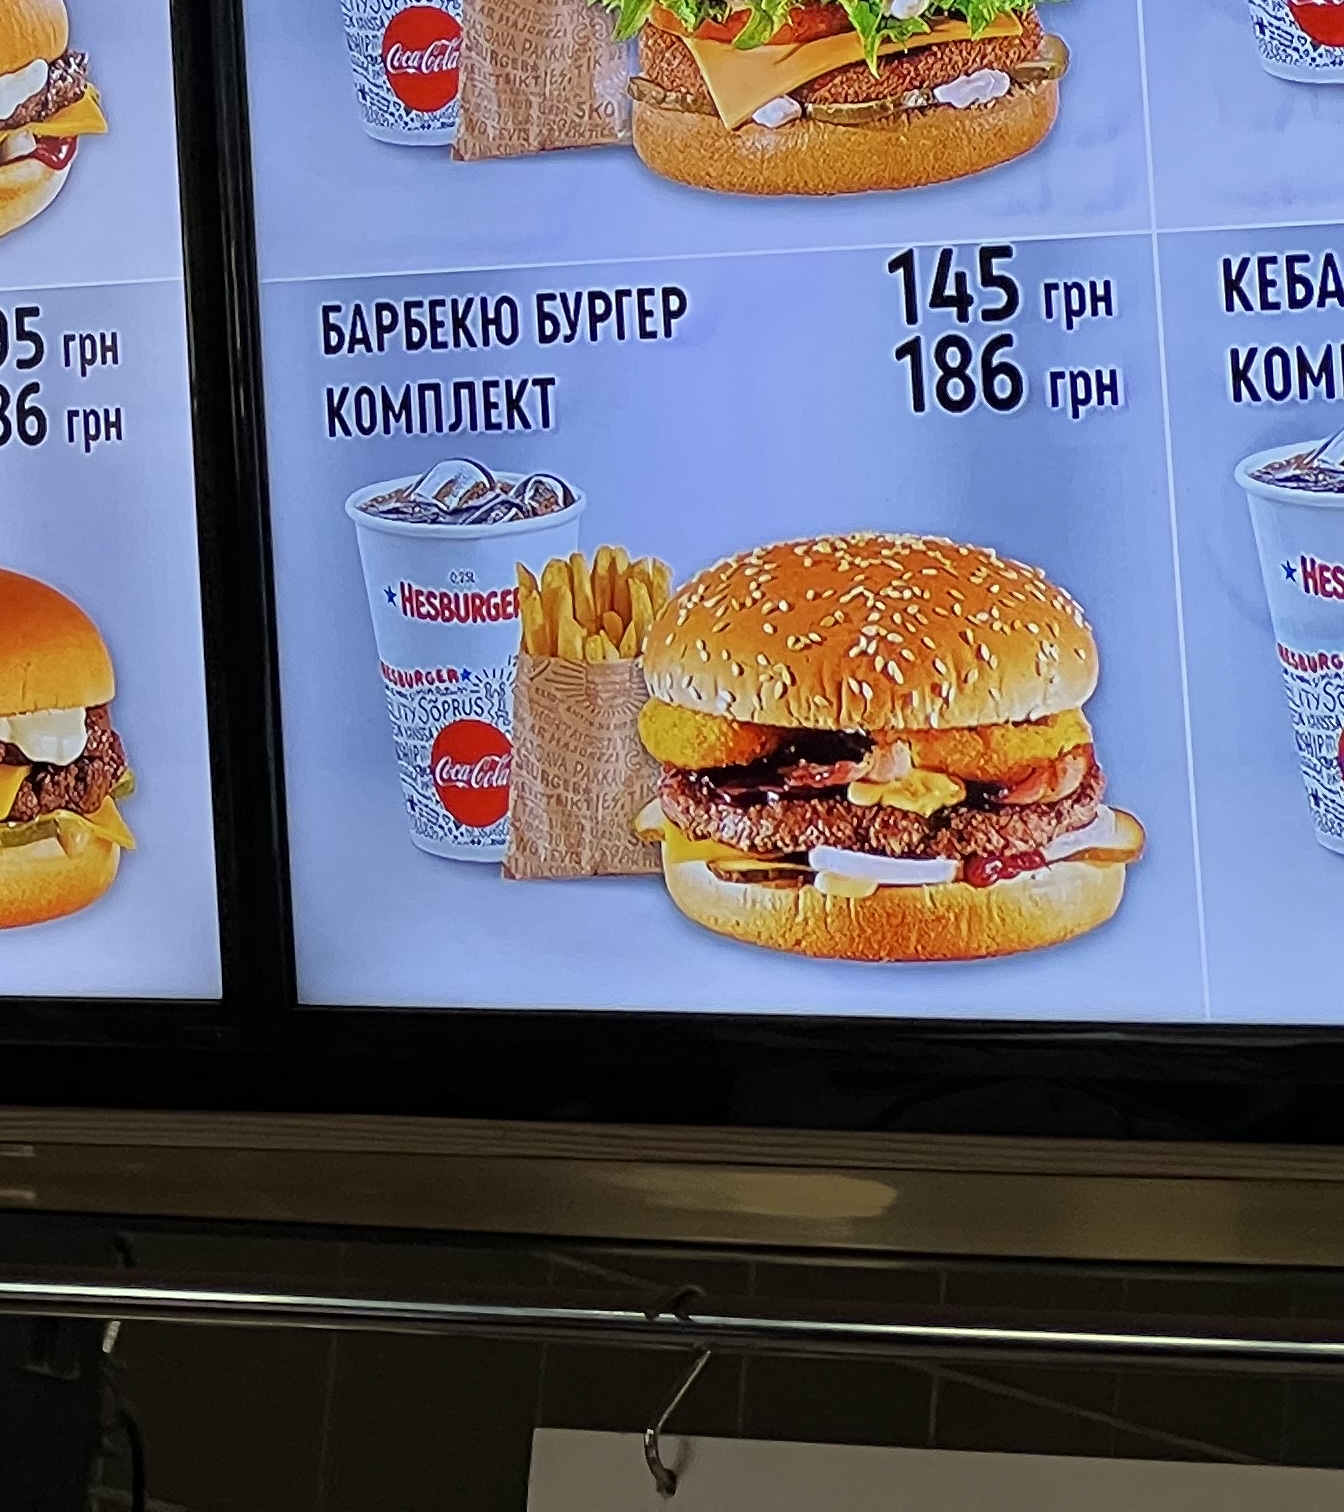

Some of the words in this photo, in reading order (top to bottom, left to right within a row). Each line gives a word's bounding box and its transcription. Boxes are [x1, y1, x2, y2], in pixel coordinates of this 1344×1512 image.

[887, 245, 1020, 326] 145
[1043, 279, 1113, 331] грн
[1222, 252, 1344, 313] КЕБА
[321, 295, 520, 356] БАРБЕКЮ
[535, 286, 688, 345] БУРГЕР
[63, 331, 119, 378] грн
[895, 333, 1024, 414] 186
[1049, 368, 1119, 420] грн
[1229, 343, 1344, 403] КОМ
[66, 407, 123, 454] грн
[326, 377, 556, 438] КОМПЛЕКТ
